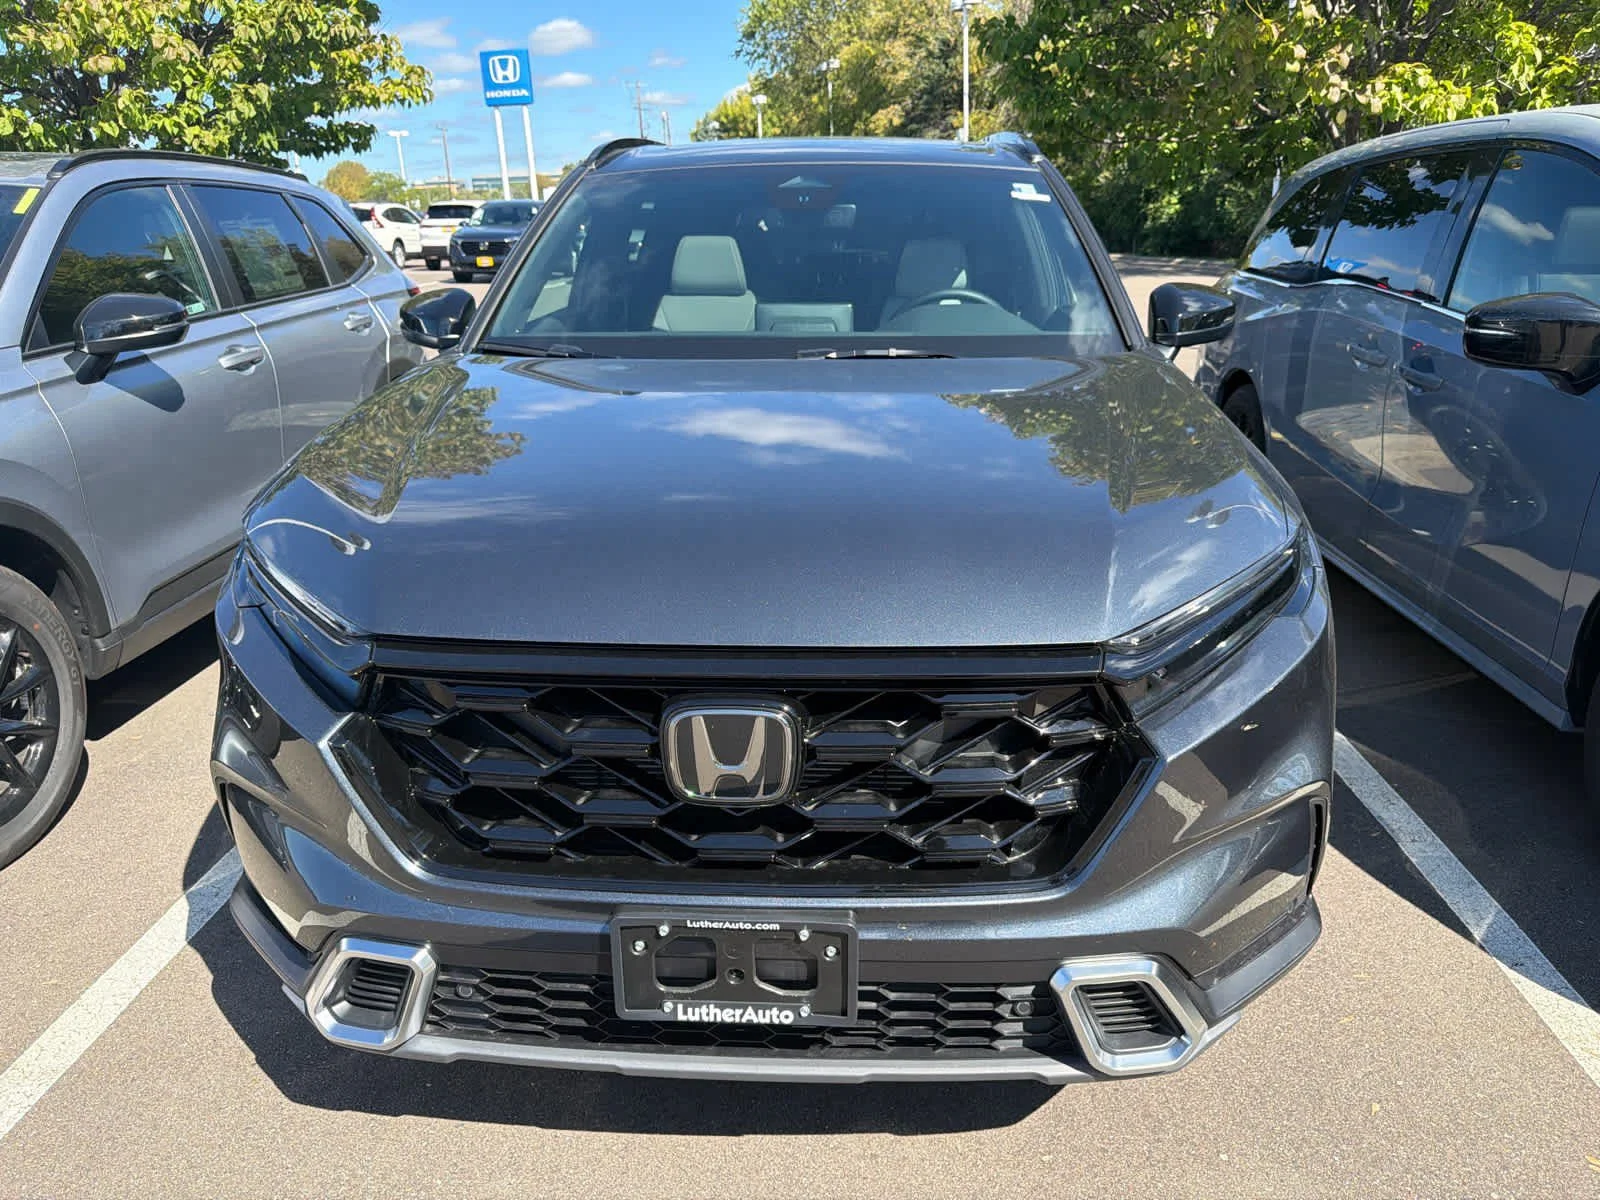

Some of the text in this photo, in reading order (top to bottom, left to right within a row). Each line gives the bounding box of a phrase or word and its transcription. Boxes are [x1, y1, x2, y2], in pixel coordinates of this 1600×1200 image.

[486, 89, 529, 98] HONDA
[22, 593, 77, 662] NERGY
[686, 919, 780, 931] LutherAuto.com
[677, 1003, 794, 1024] LutherAuto
